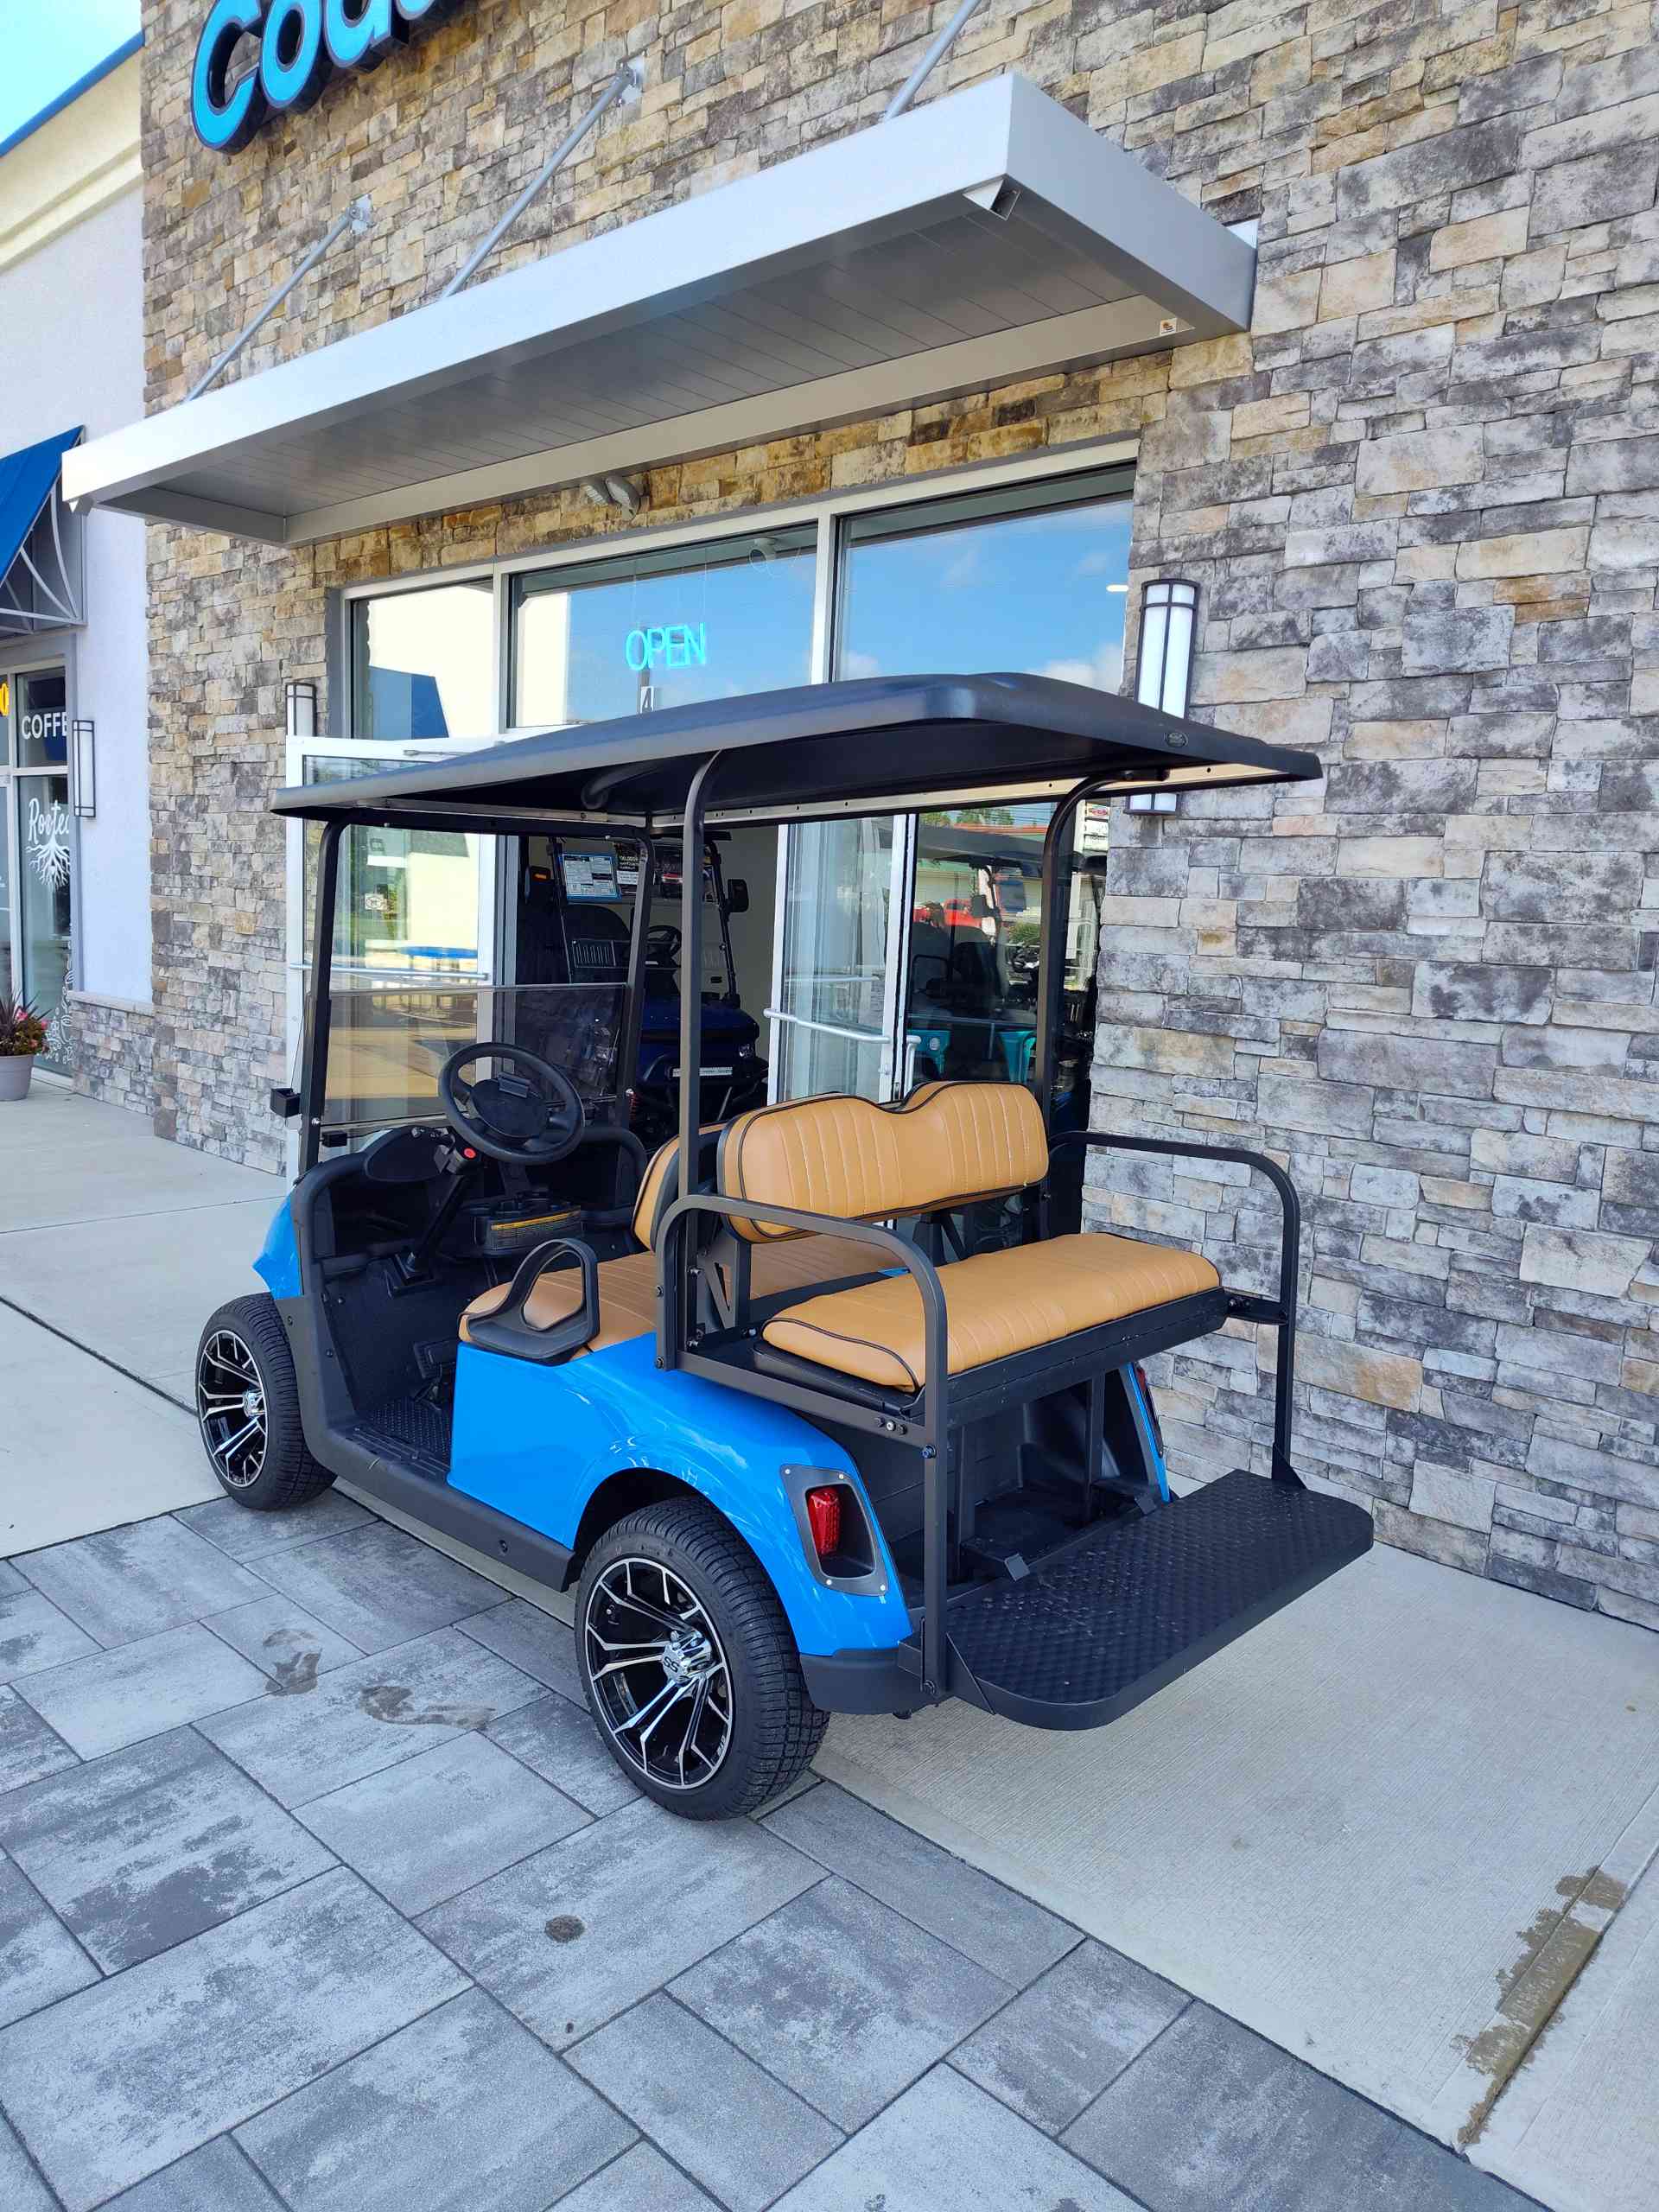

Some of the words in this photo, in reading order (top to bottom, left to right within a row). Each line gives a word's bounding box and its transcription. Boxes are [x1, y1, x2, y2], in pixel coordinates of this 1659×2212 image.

[190, 0, 435, 150] Coa
[625, 622, 706, 671] OPEN
[663, 1656, 680, 1673] SS
